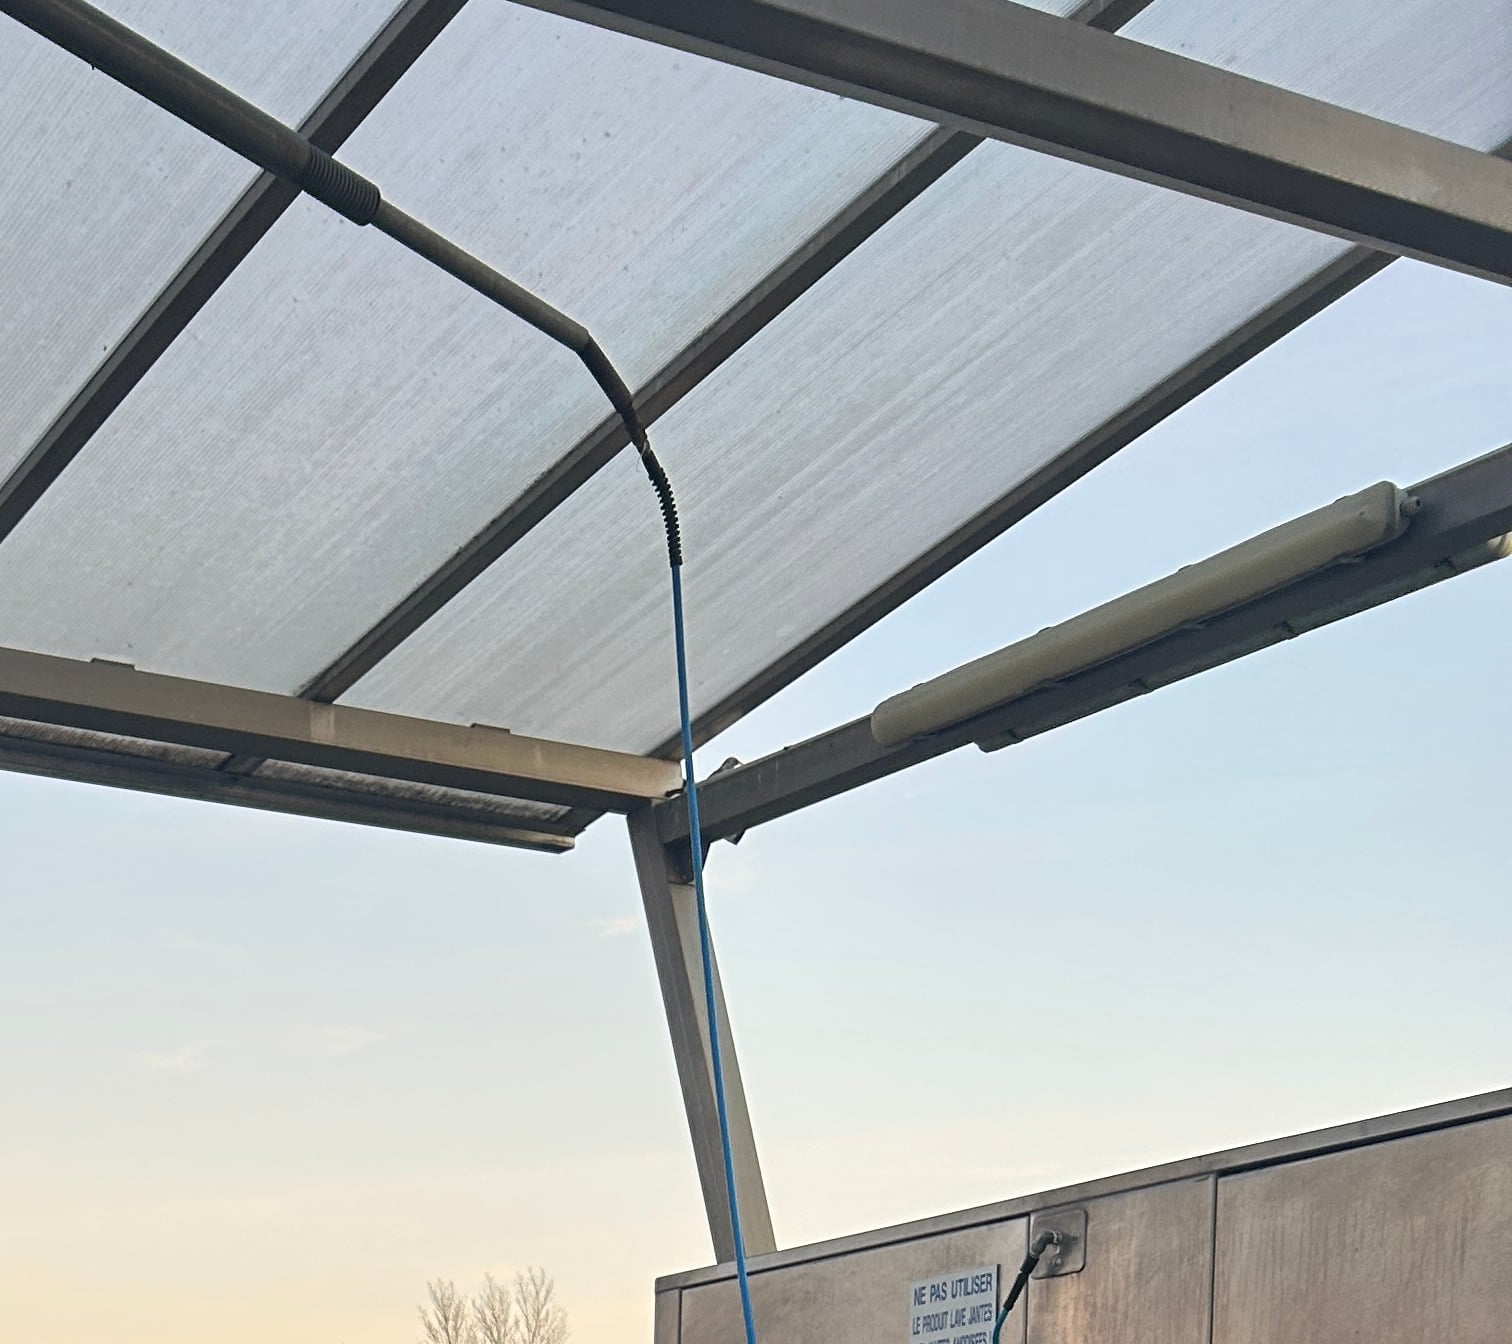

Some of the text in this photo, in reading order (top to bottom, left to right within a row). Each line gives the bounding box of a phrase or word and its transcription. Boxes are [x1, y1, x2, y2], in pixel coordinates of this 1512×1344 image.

[913, 1273, 992, 1307] NE PAS UTILISER
[912, 1316, 921, 1335] LE
